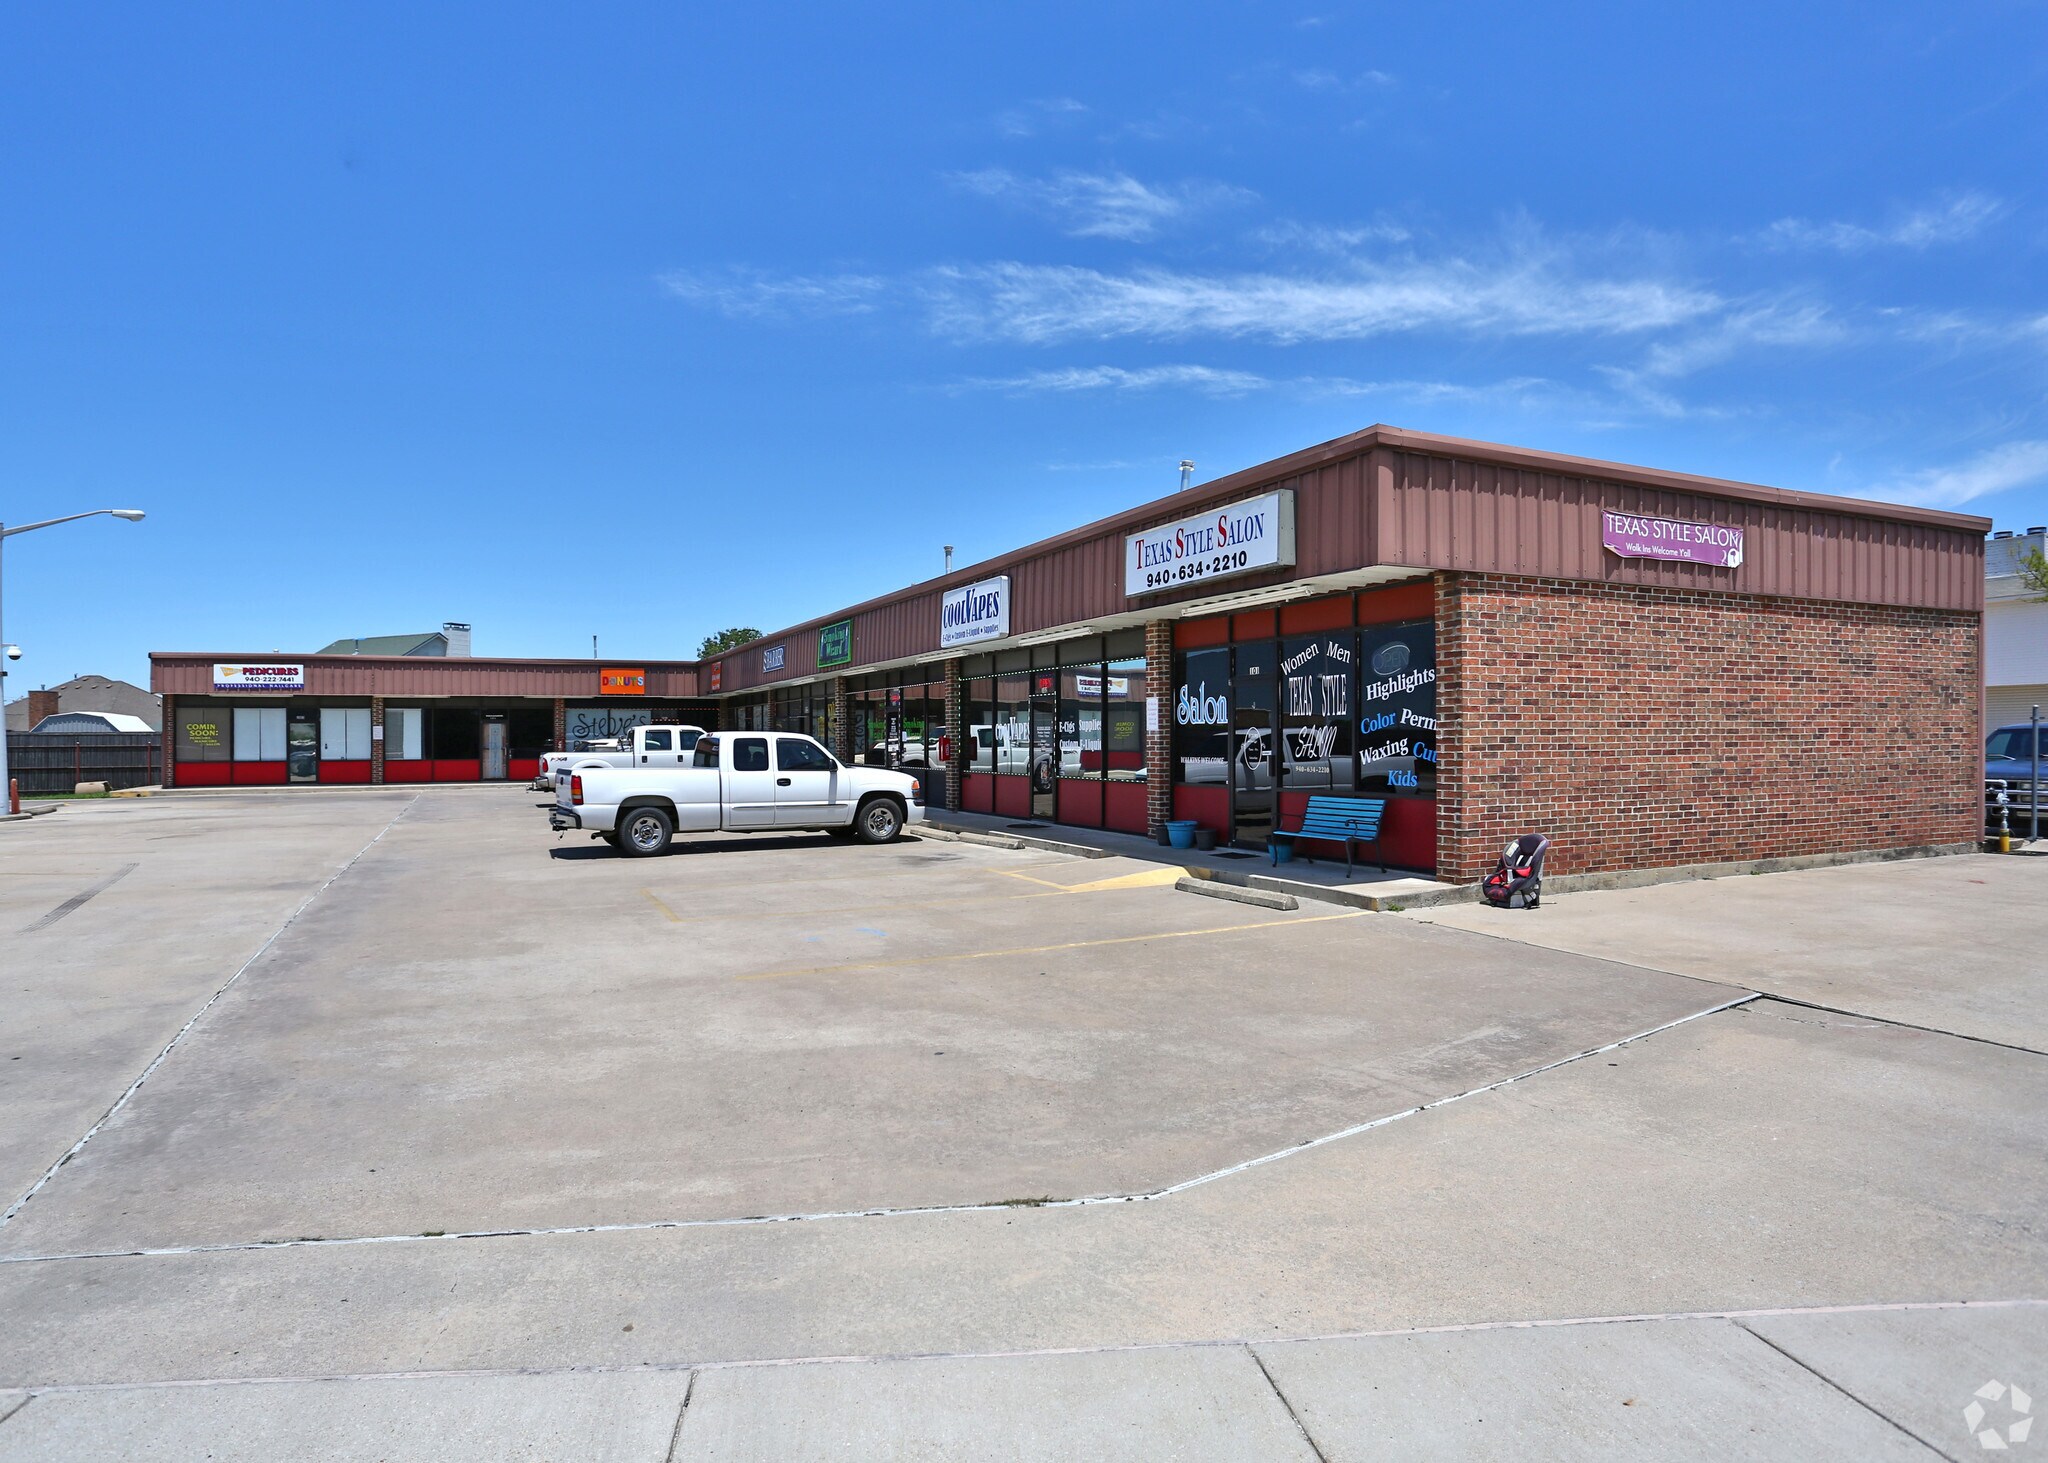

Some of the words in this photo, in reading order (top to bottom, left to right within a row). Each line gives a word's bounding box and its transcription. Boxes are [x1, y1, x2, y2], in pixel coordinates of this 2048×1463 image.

[1135, 538, 1172, 570] TEXAS
[1175, 527, 1214, 559] STYLE
[1217, 512, 1265, 548] SALON
[1606, 513, 1649, 537] TEXAS
[1653, 520, 1691, 542] STYLE
[1695, 526, 1739, 548] SALON
[1626, 542, 1641, 552] Walk
[1642, 544, 1651, 553] Ins
[1652, 545, 1678, 556] Welcome
[943, 588, 999, 629] COOLVAPES
[242, 667, 299, 676] PEDICURES
[1281, 642, 1320, 675] Women
[1326, 640, 1351, 663] Men
[602, 676, 644, 686] DONUTS
[1288, 675, 1313, 717] TEXAS
[1322, 673, 1347, 717] STYLE
[1365, 668, 1435, 701] Highlights
[1177, 681, 1229, 725] Salon
[1058, 721, 1076, 734] E-Cigs
[1360, 711, 1396, 735] Color
[1359, 738, 1409, 765] Waxing
[1386, 769, 1418, 787] Kids
